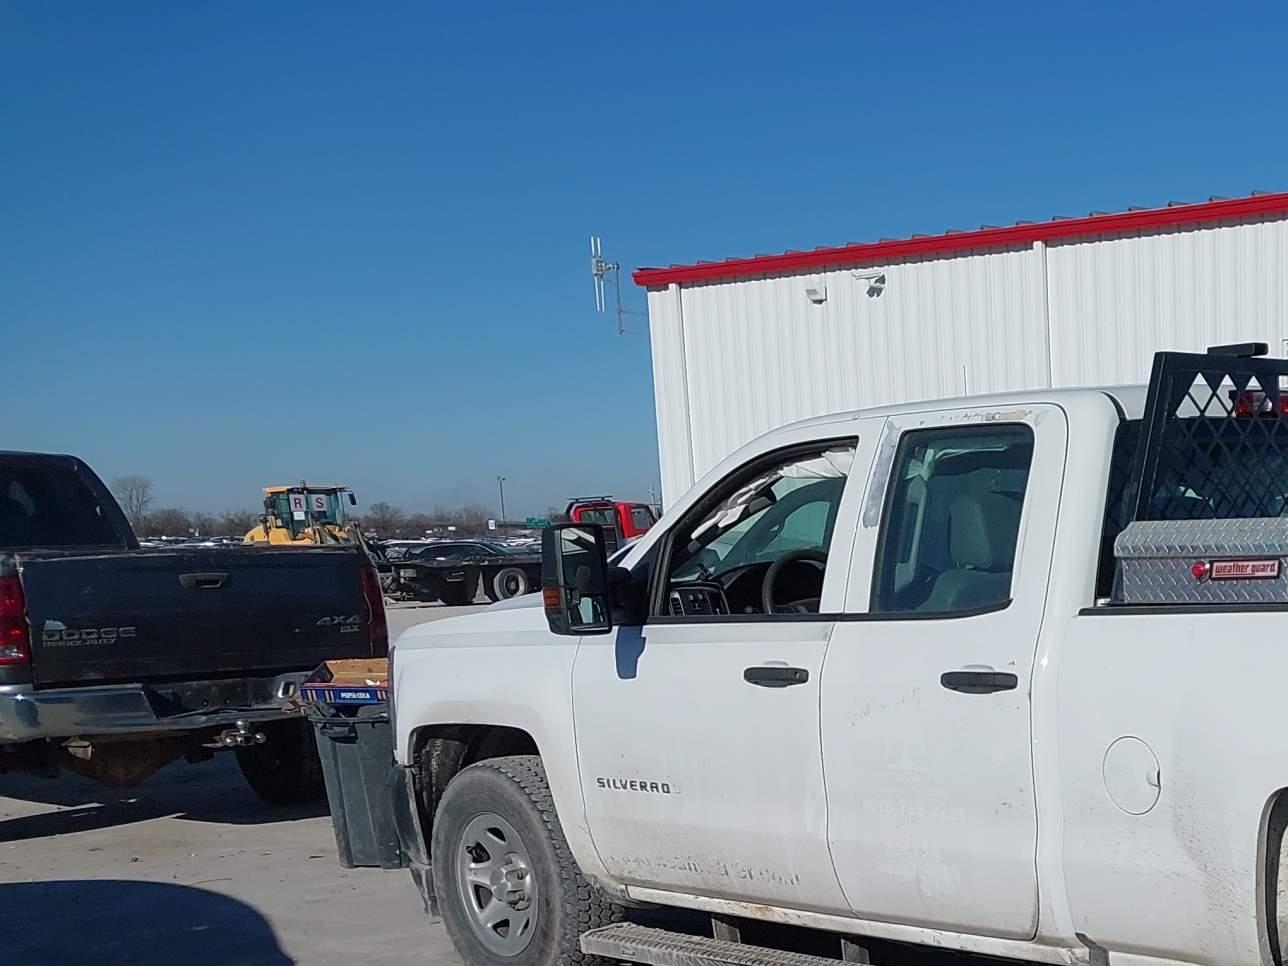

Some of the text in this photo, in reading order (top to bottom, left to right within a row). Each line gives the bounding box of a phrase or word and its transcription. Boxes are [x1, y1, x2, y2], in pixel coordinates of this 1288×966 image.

[293, 497, 324, 509] R S
[1215, 562, 1276, 574] weather guard
[43, 627, 136, 640] DODGE
